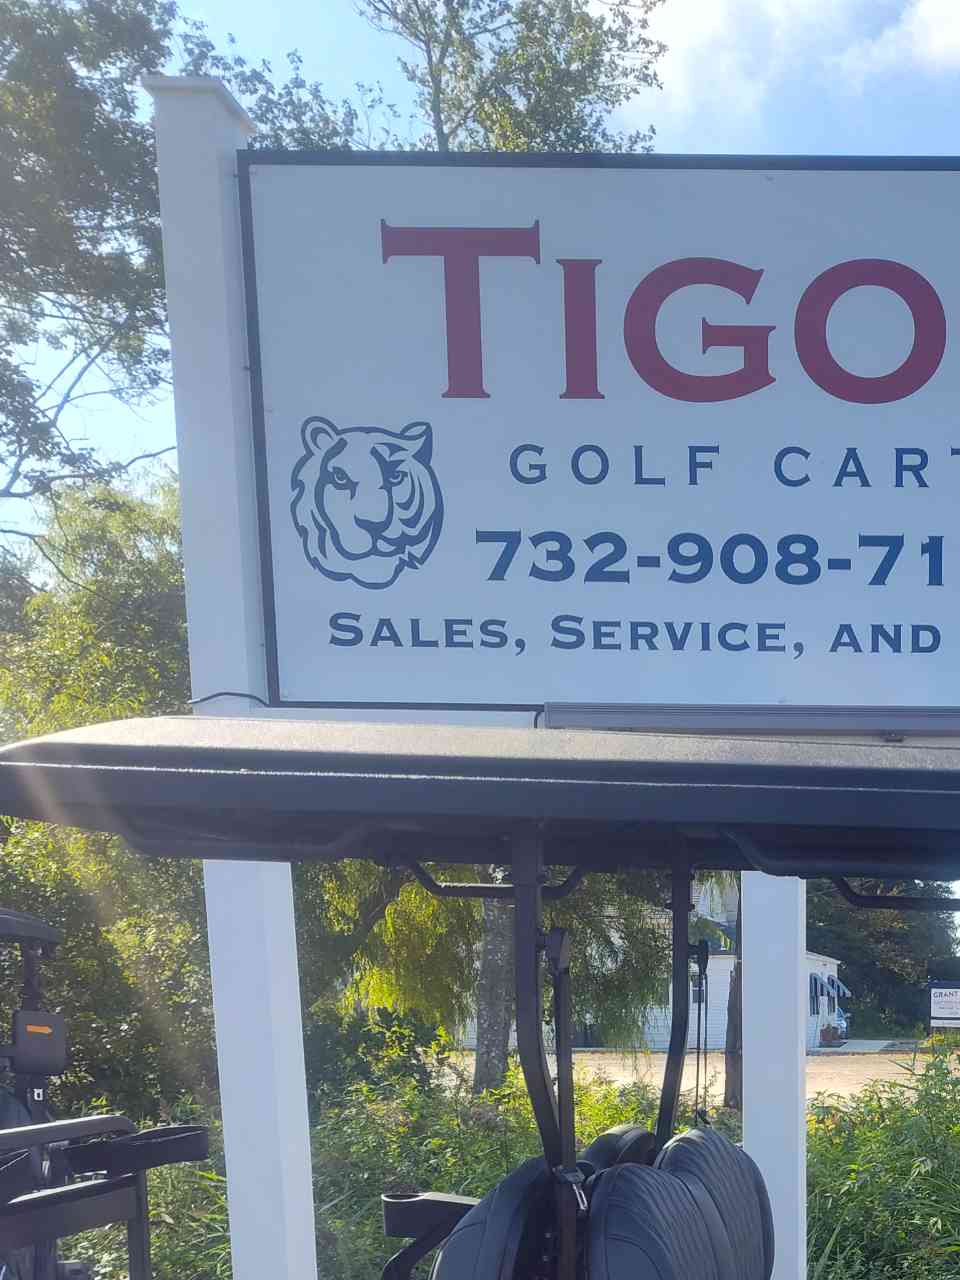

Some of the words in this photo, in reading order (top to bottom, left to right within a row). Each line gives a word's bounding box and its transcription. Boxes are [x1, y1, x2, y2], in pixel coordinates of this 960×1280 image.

[509, 443, 720, 486] GOLF
[328, 611, 526, 657] SALES,
[550, 614, 804, 660] SERVICE,
[829, 623, 941, 654] AND
